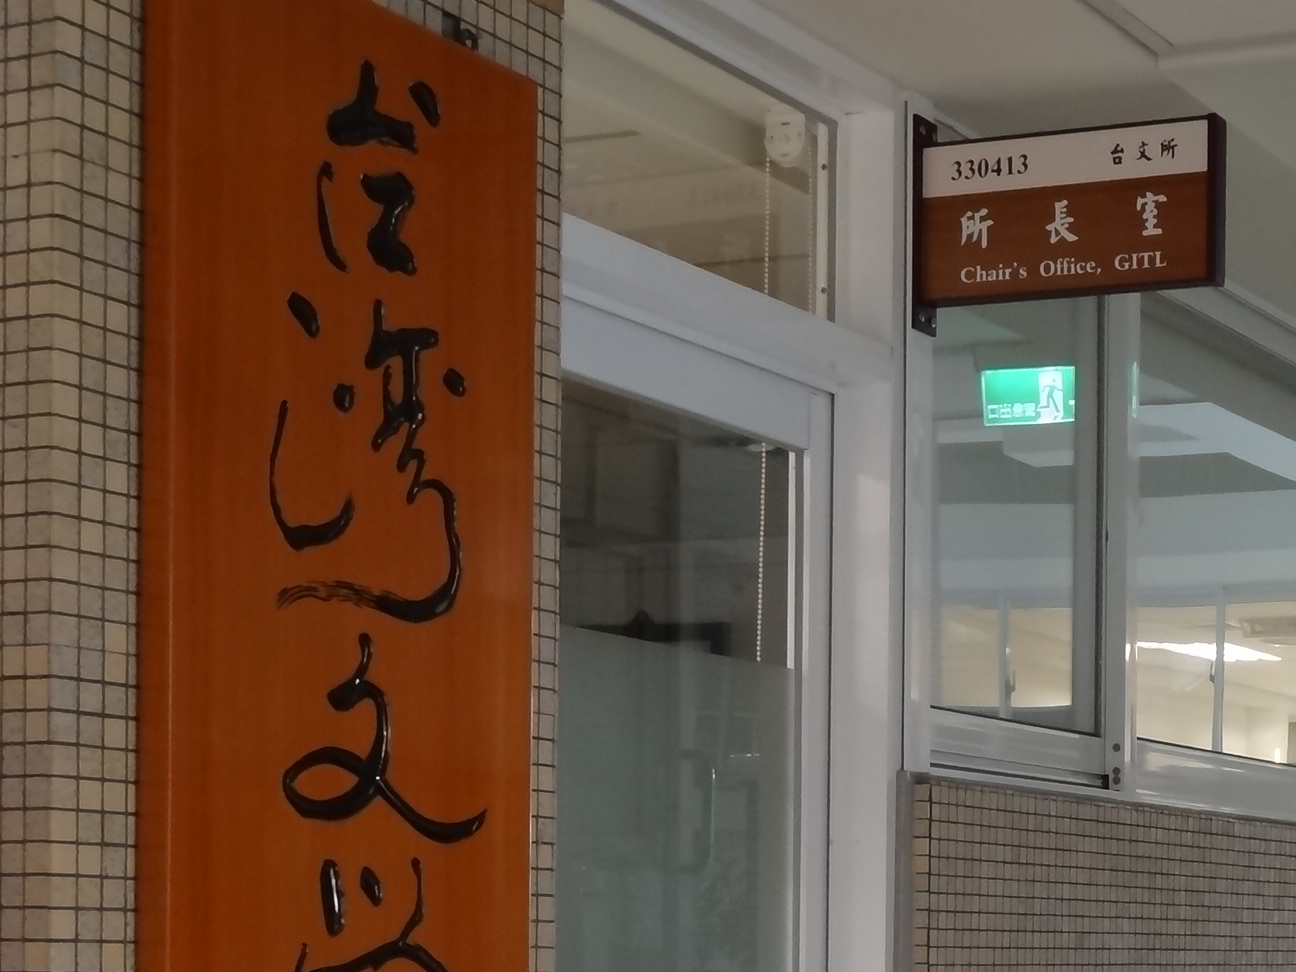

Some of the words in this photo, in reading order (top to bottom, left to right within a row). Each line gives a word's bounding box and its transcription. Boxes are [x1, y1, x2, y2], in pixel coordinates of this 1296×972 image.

[1109, 137, 1179, 166] 台文所
[950, 153, 1029, 182] 330413
[960, 191, 1168, 249] 所長室
[1039, 257, 1102, 277] Office,
[1114, 251, 1167, 271] GITL
